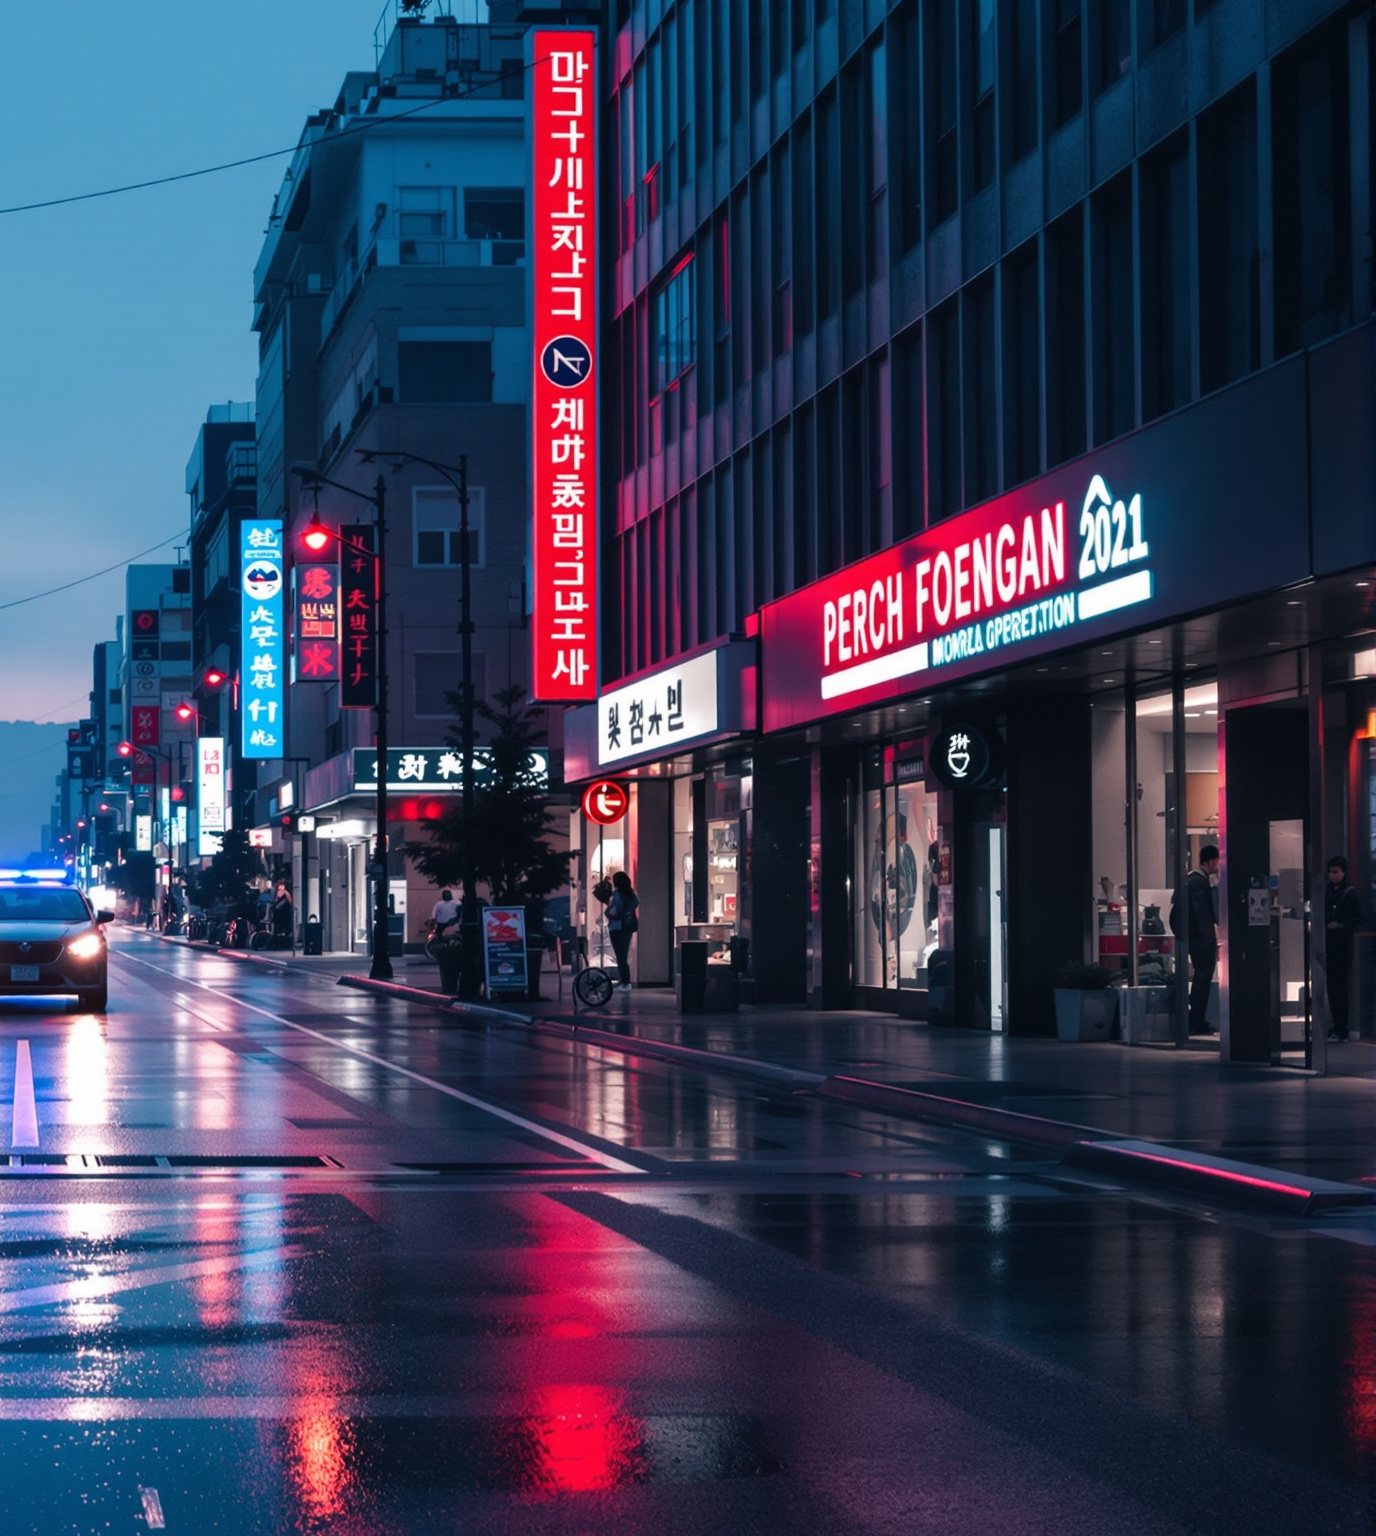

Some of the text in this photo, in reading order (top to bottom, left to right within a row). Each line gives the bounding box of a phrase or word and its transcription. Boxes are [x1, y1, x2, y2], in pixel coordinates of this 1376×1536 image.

[824, 502, 1065, 666] PERCH FOENGAN
[1078, 493, 1149, 580] 2021
